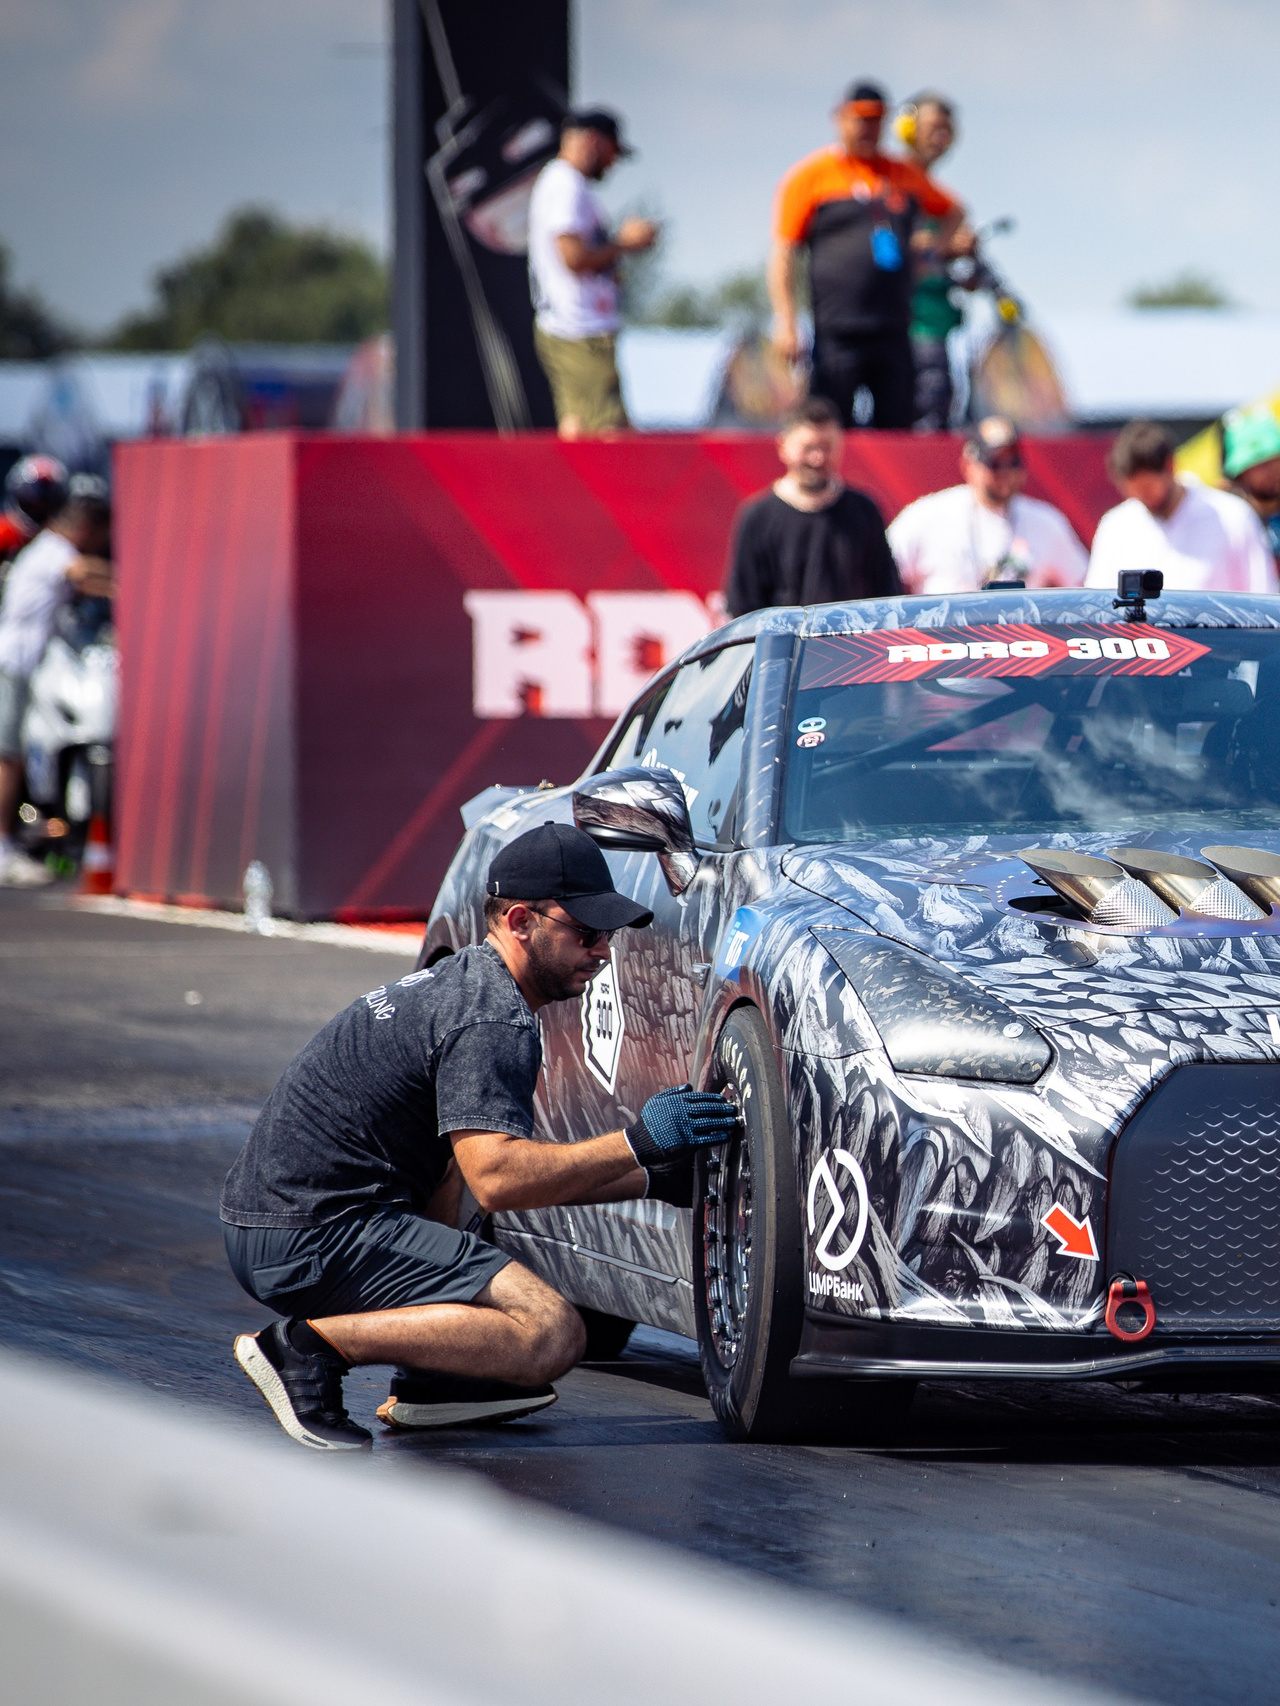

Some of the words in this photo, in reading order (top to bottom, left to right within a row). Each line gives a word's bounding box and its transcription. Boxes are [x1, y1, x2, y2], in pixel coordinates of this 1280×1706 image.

[464, 589, 731, 719] RD
[1066, 637, 1171, 660] 300
[596, 999, 613, 1040] 300
[808, 1270, 864, 1302] ЦМРБанк
